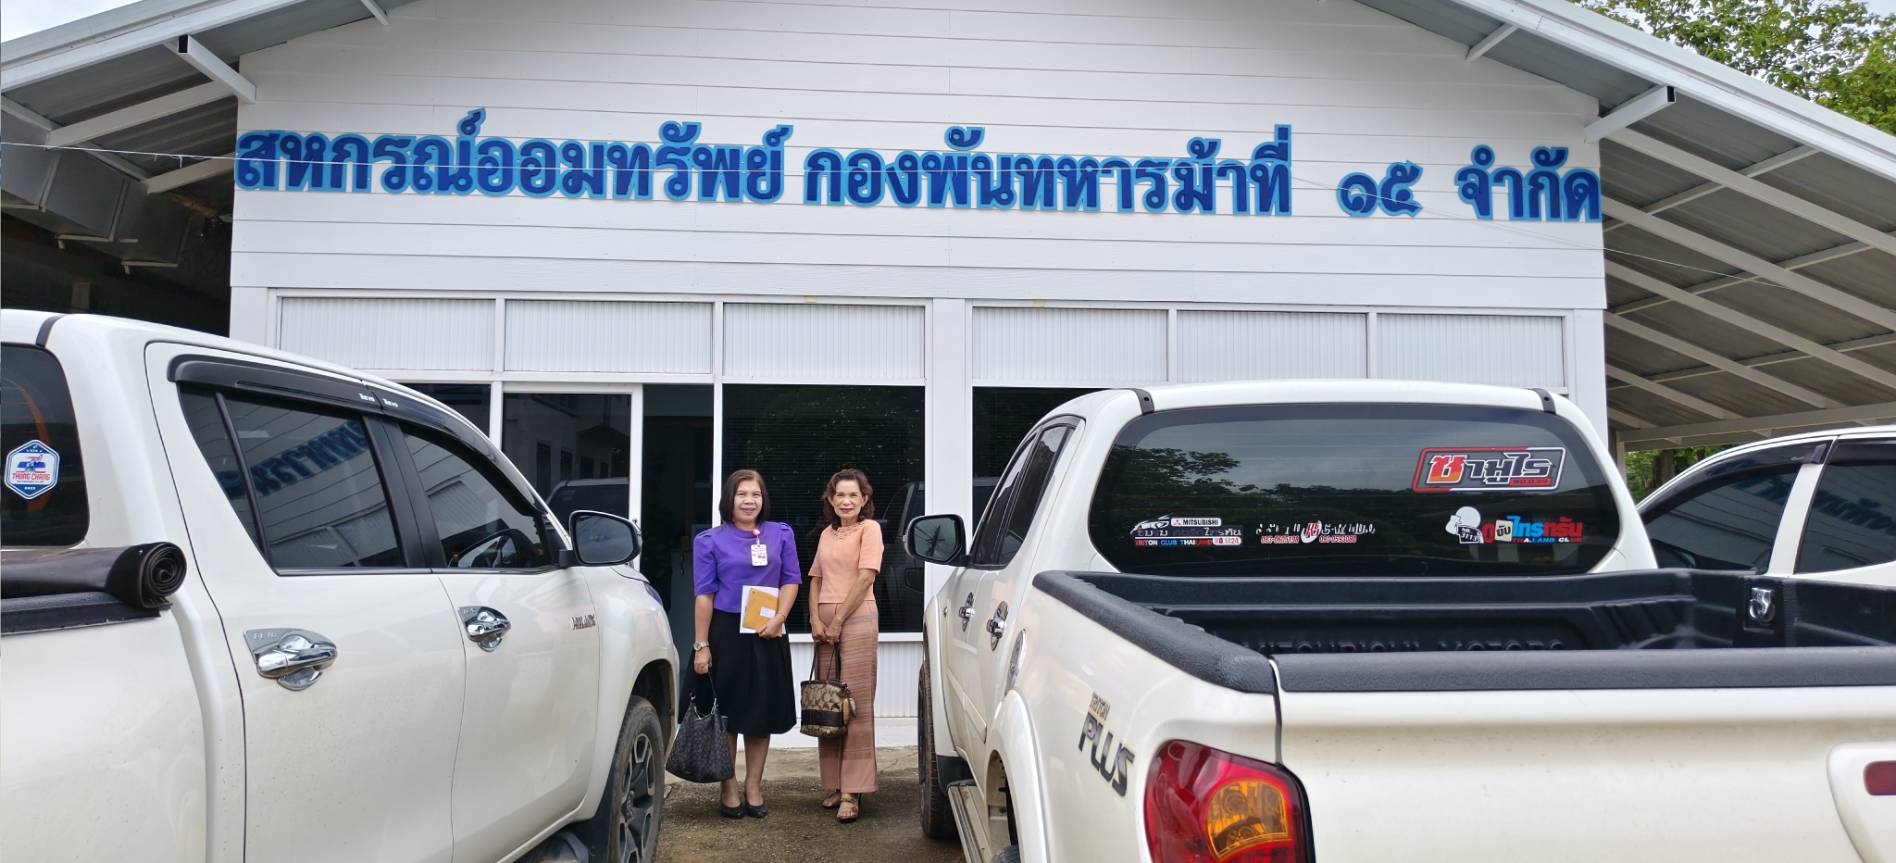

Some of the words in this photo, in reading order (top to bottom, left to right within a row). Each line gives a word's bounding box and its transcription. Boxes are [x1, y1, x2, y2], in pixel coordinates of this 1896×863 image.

[235, 107, 793, 205] สหกรณ์ออมทรัพย์
[803, 124, 1292, 217] กองพันทหารม้าที่
[1336, 160, 1423, 218] ๑๕
[1454, 144, 1602, 223] จำกัด
[1182, 518, 1220, 526] MITSUBISHI
[1078, 711, 1135, 797] PLUS
